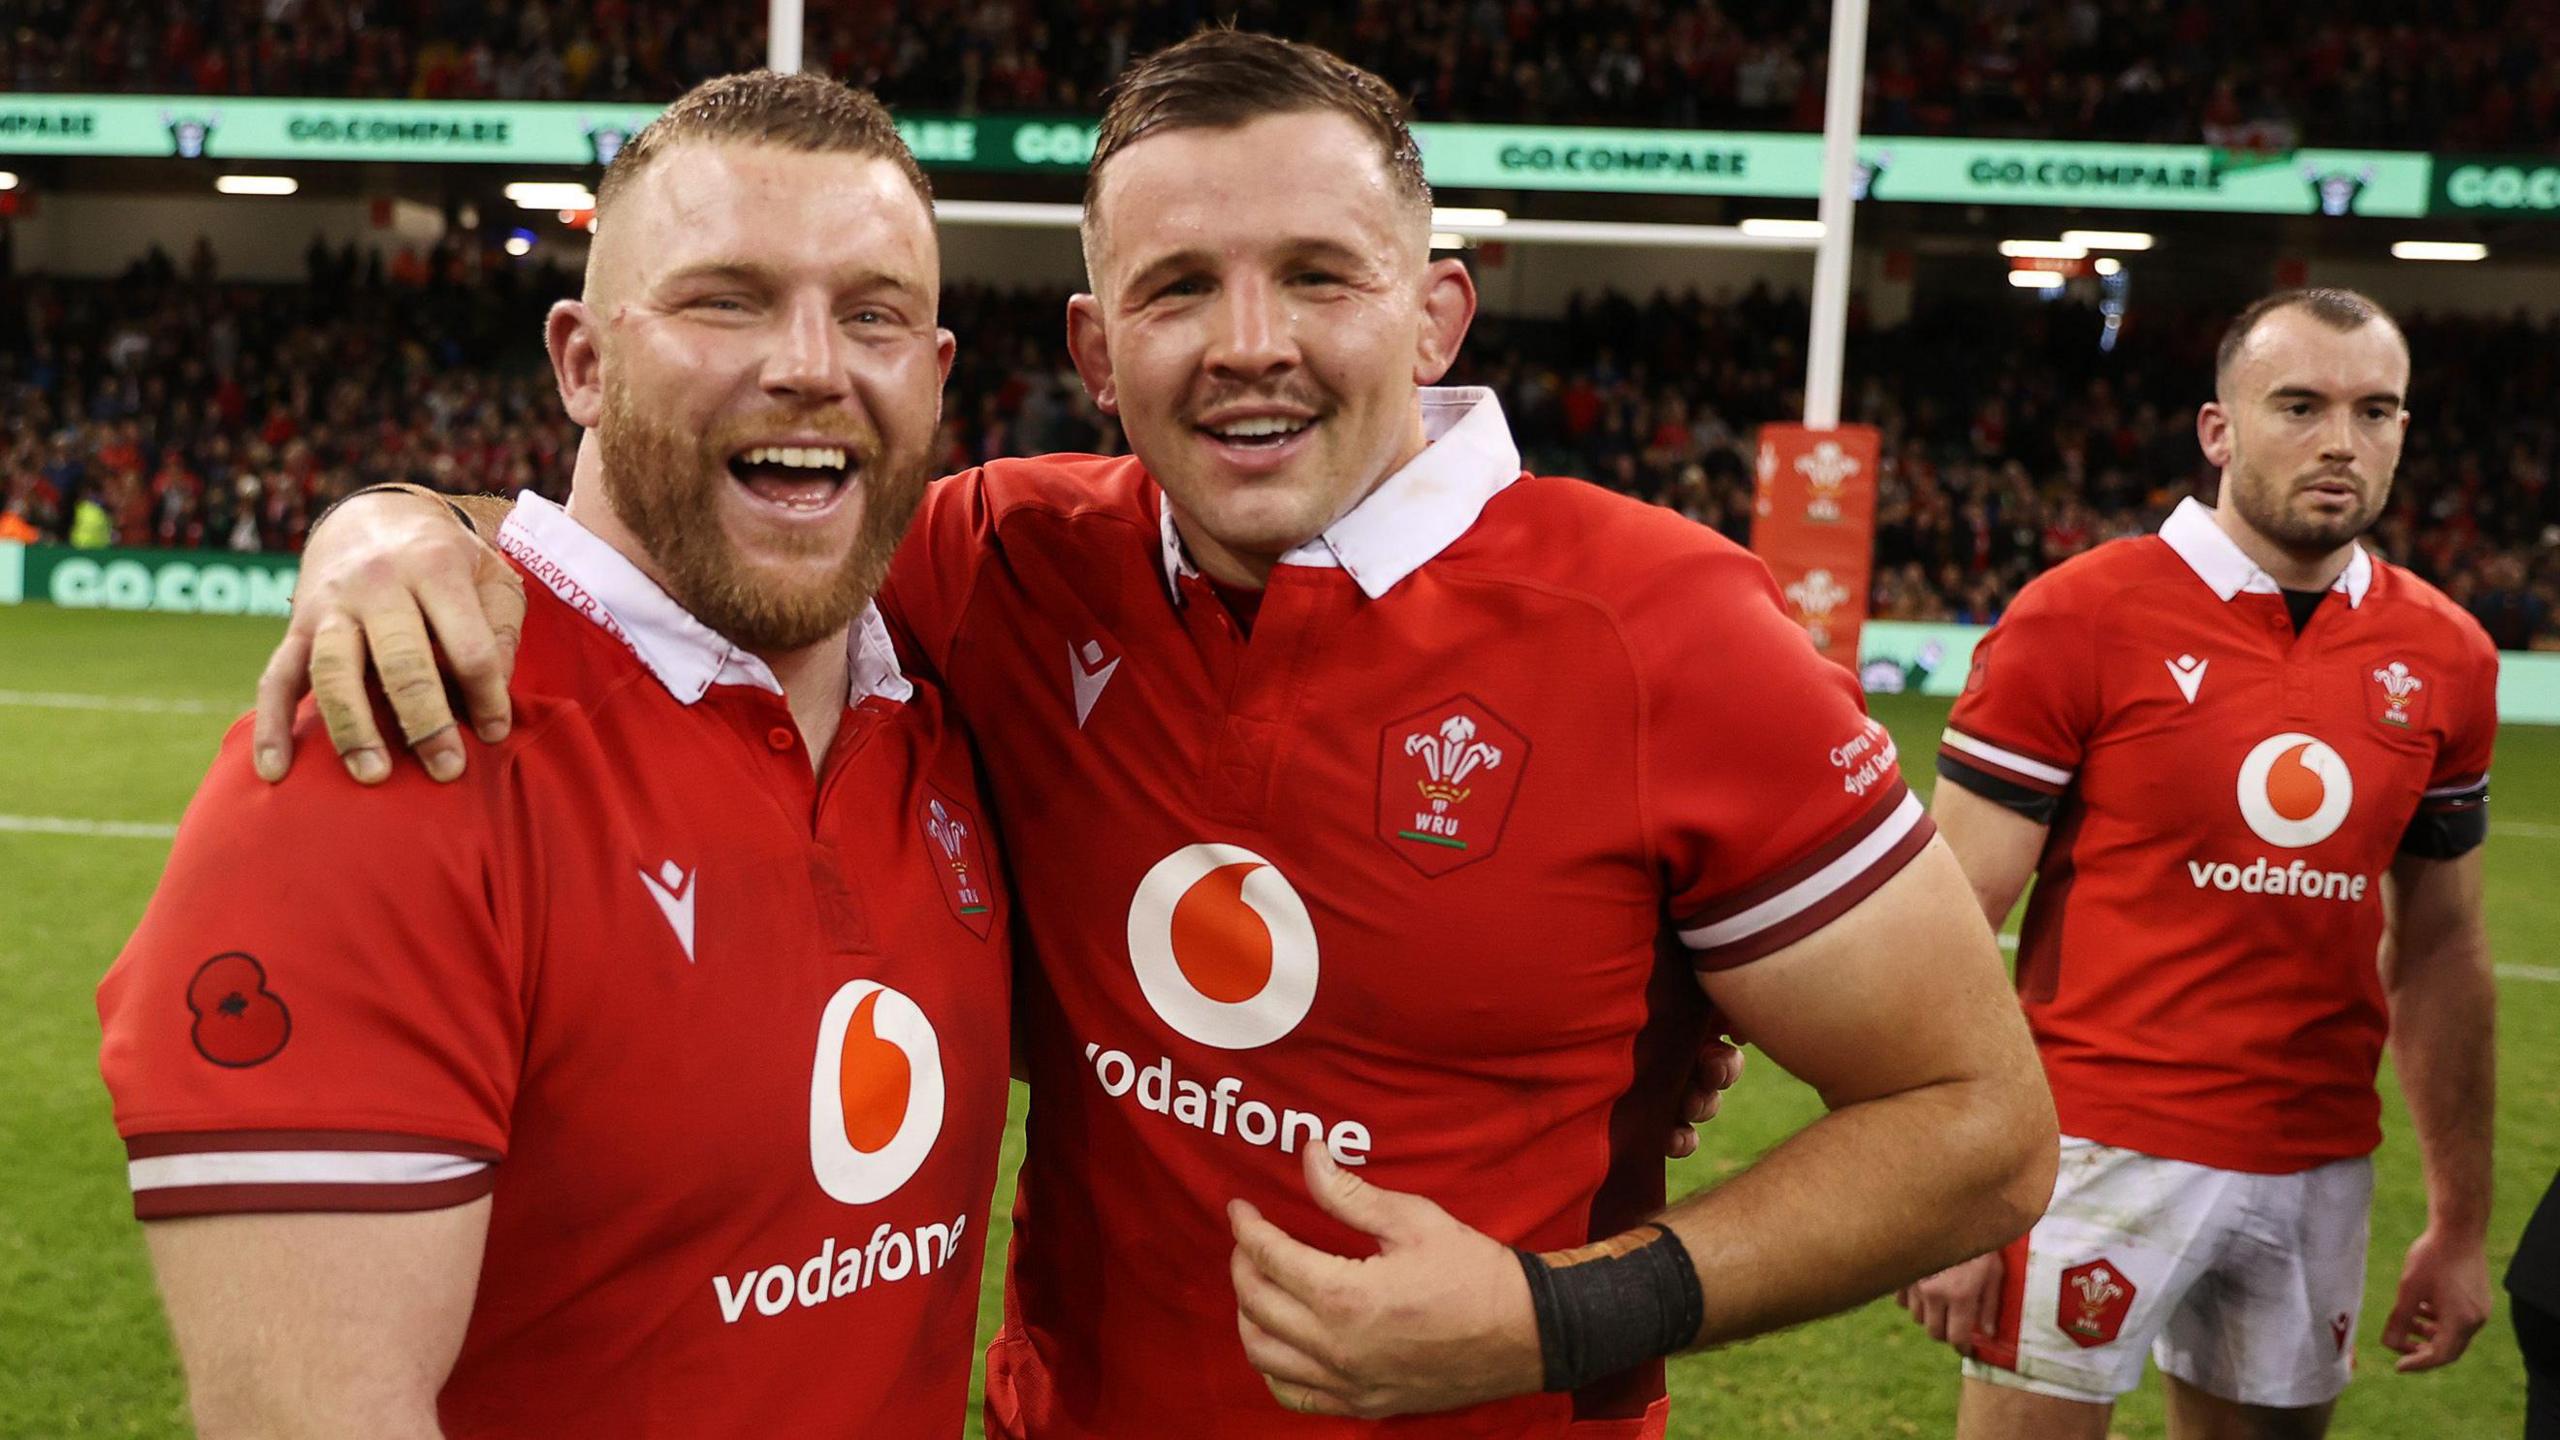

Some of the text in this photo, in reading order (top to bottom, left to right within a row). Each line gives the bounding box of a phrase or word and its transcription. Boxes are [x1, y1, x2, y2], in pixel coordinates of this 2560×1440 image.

[1829, 734, 1871, 769] Cymru
[1415, 811, 1459, 837] WRU
[2187, 856, 2369, 902] vodafone
[711, 1213, 967, 1325] vodafone
